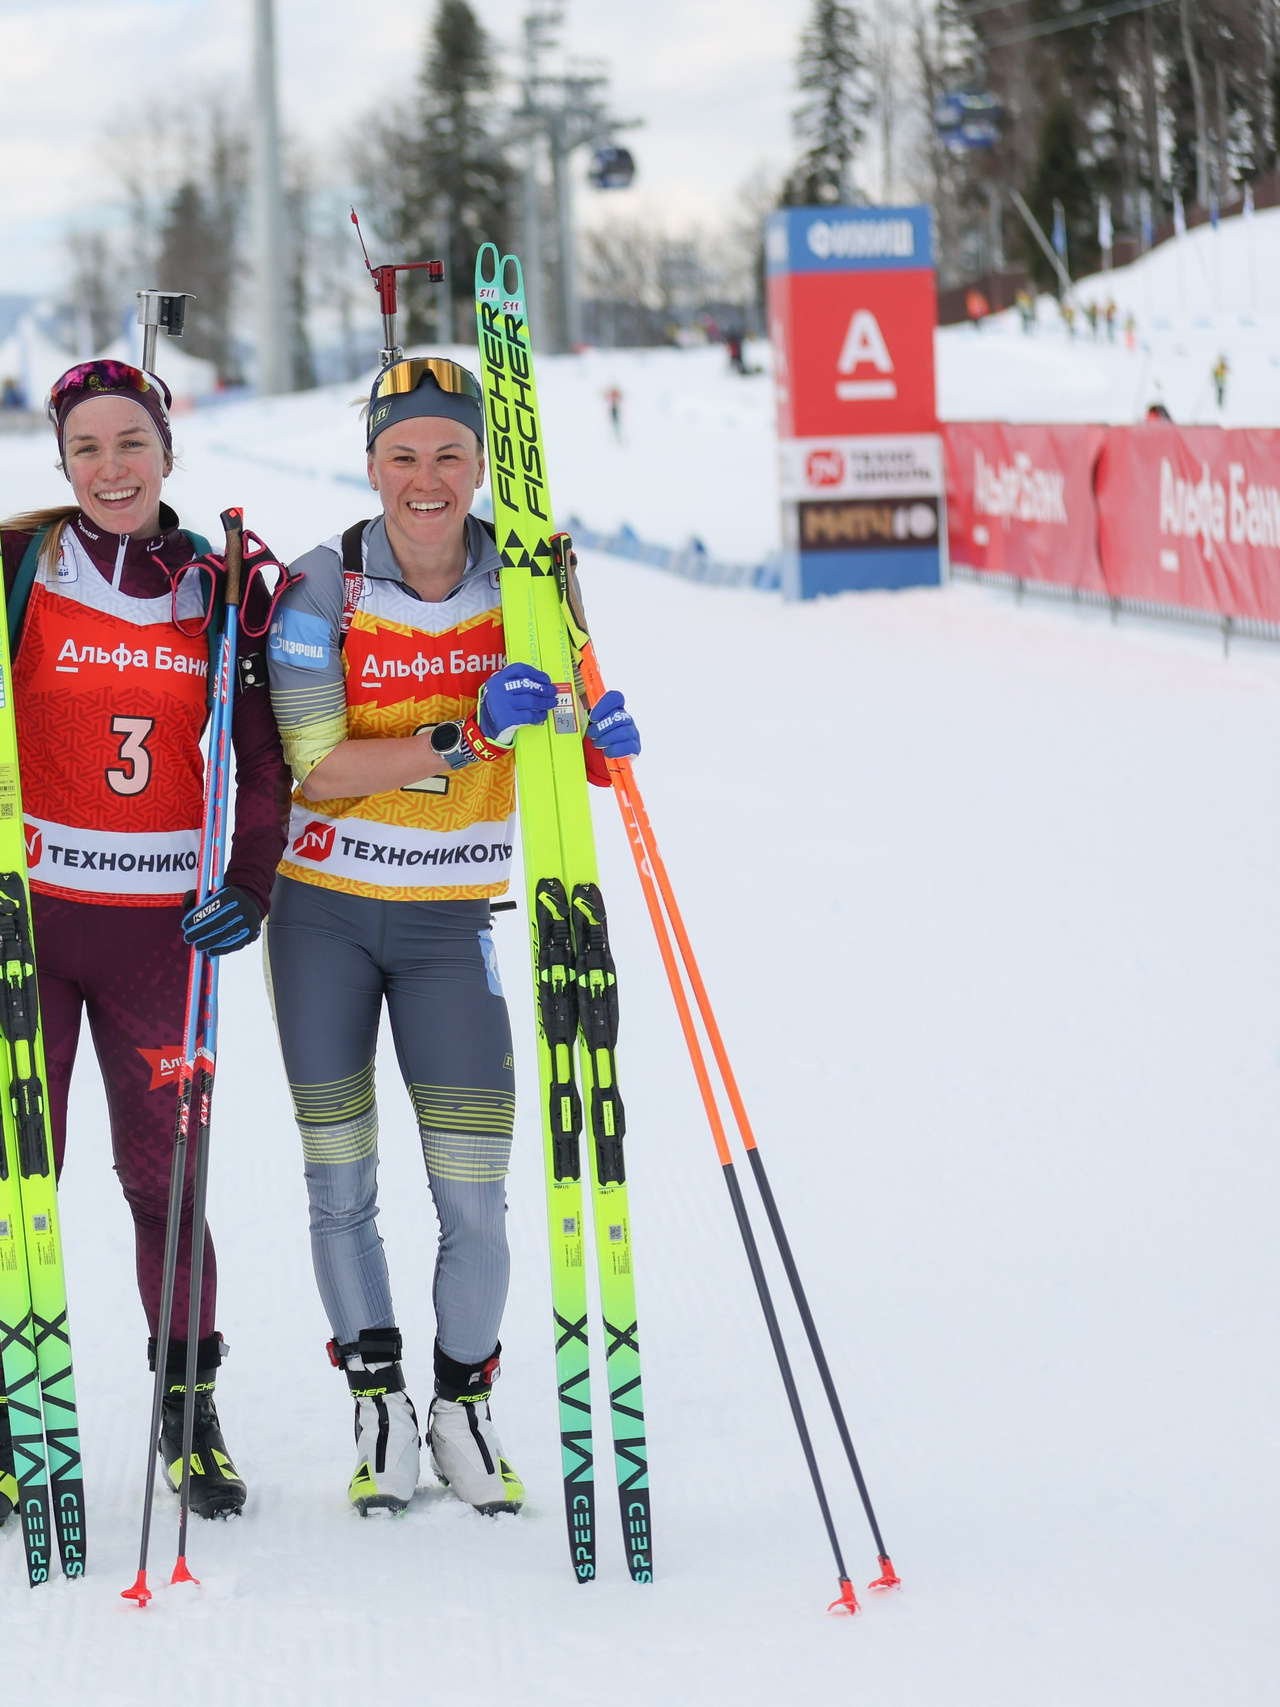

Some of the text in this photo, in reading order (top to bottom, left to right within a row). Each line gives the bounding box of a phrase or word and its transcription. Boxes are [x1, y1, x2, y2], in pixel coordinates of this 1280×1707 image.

[480, 289, 495, 298] 511
[503, 302, 519, 311] 511
[481, 302, 519, 513] FISCHER
[505, 314, 548, 521] FISCHER
[1160, 456, 1227, 562] Альфа
[57, 638, 148, 672] Альфа
[154, 646, 209, 678] Банк
[281, 638, 324, 659] ГАЗФОНД
[528, 621, 539, 669] PEEDMAX
[361, 649, 508, 682] Альфа Банк
[105, 714, 156, 797] 3
[466, 727, 498, 761] LEKI
[48, 845, 199, 873] ТЕХНОНИКО
[341, 836, 513, 867] ТЕХНОНИКОЛЬ
[193, 900, 220, 924] KV+
[160, 1046, 205, 1072] Ала
[170, 1381, 216, 1393] FICHE
[351, 1387, 387, 1397] CHER
[456, 1391, 492, 1403] FISCH
